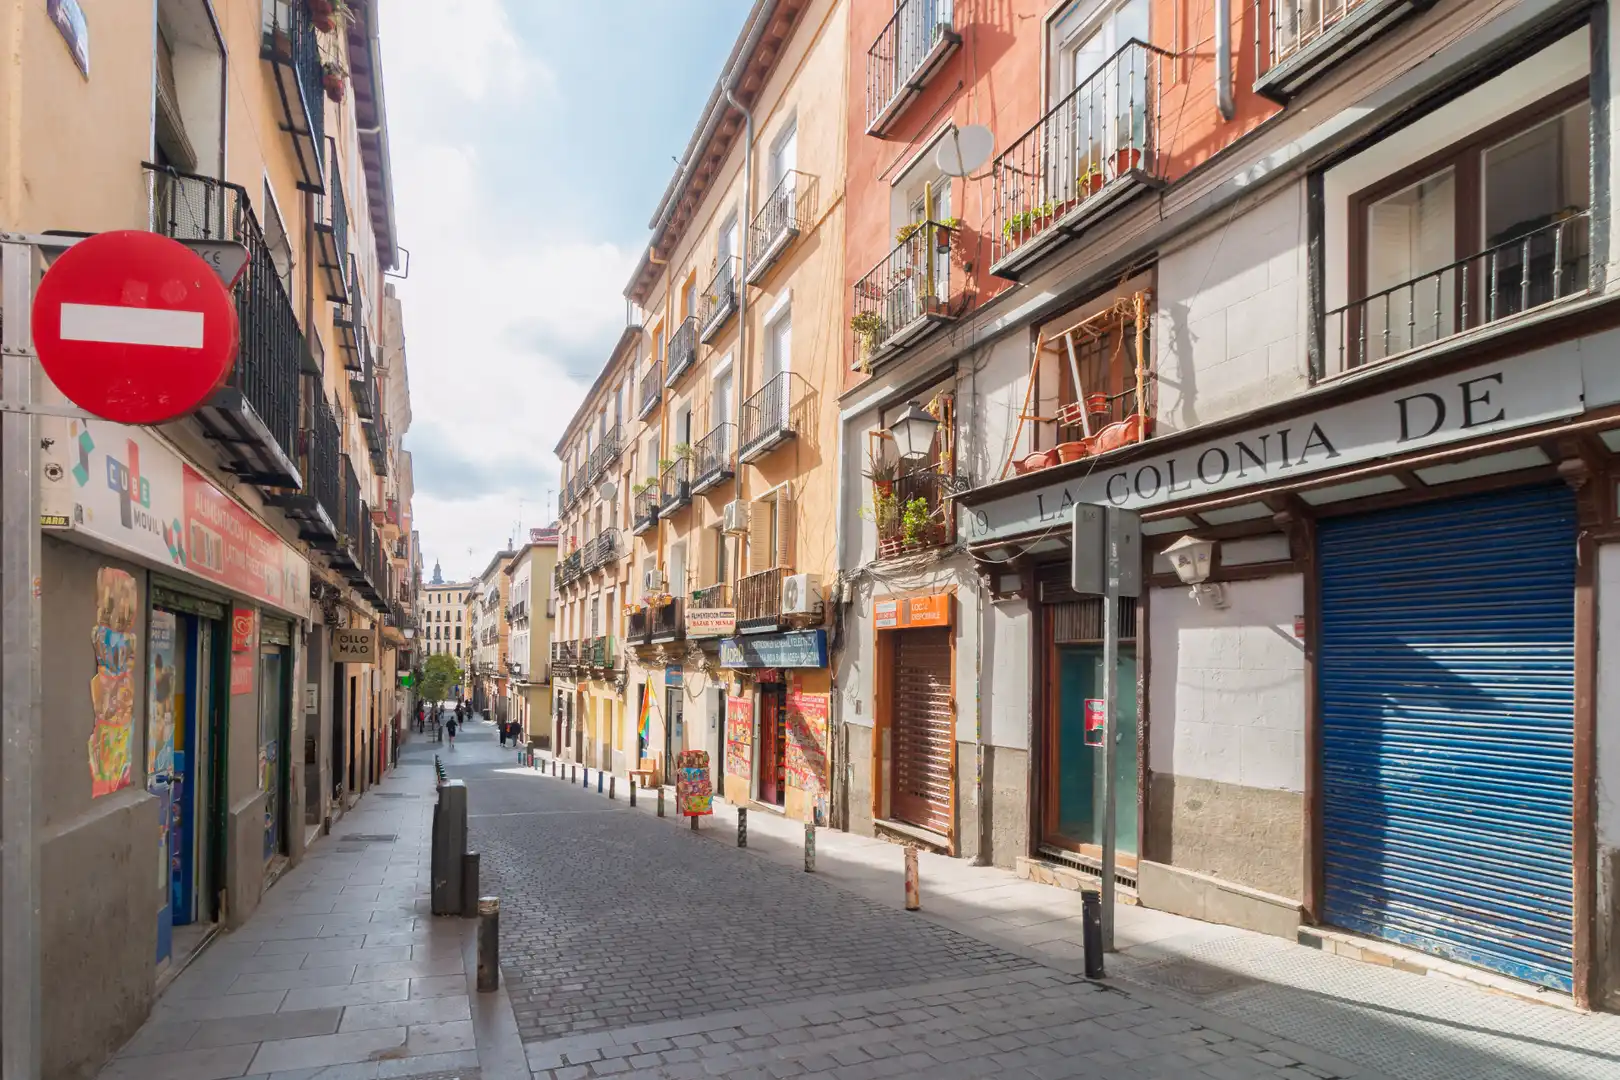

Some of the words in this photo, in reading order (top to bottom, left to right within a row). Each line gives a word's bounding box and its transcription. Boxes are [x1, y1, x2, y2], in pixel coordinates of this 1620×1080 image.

[1037, 488, 1075, 523] LA
[1106, 421, 1340, 506] COLONIA
[1394, 372, 1506, 444] DE
[108, 462, 149, 503] CUBE
[969, 510, 989, 538] 19
[340, 635, 368, 643] OLLO
[340, 645, 368, 653] MAO
